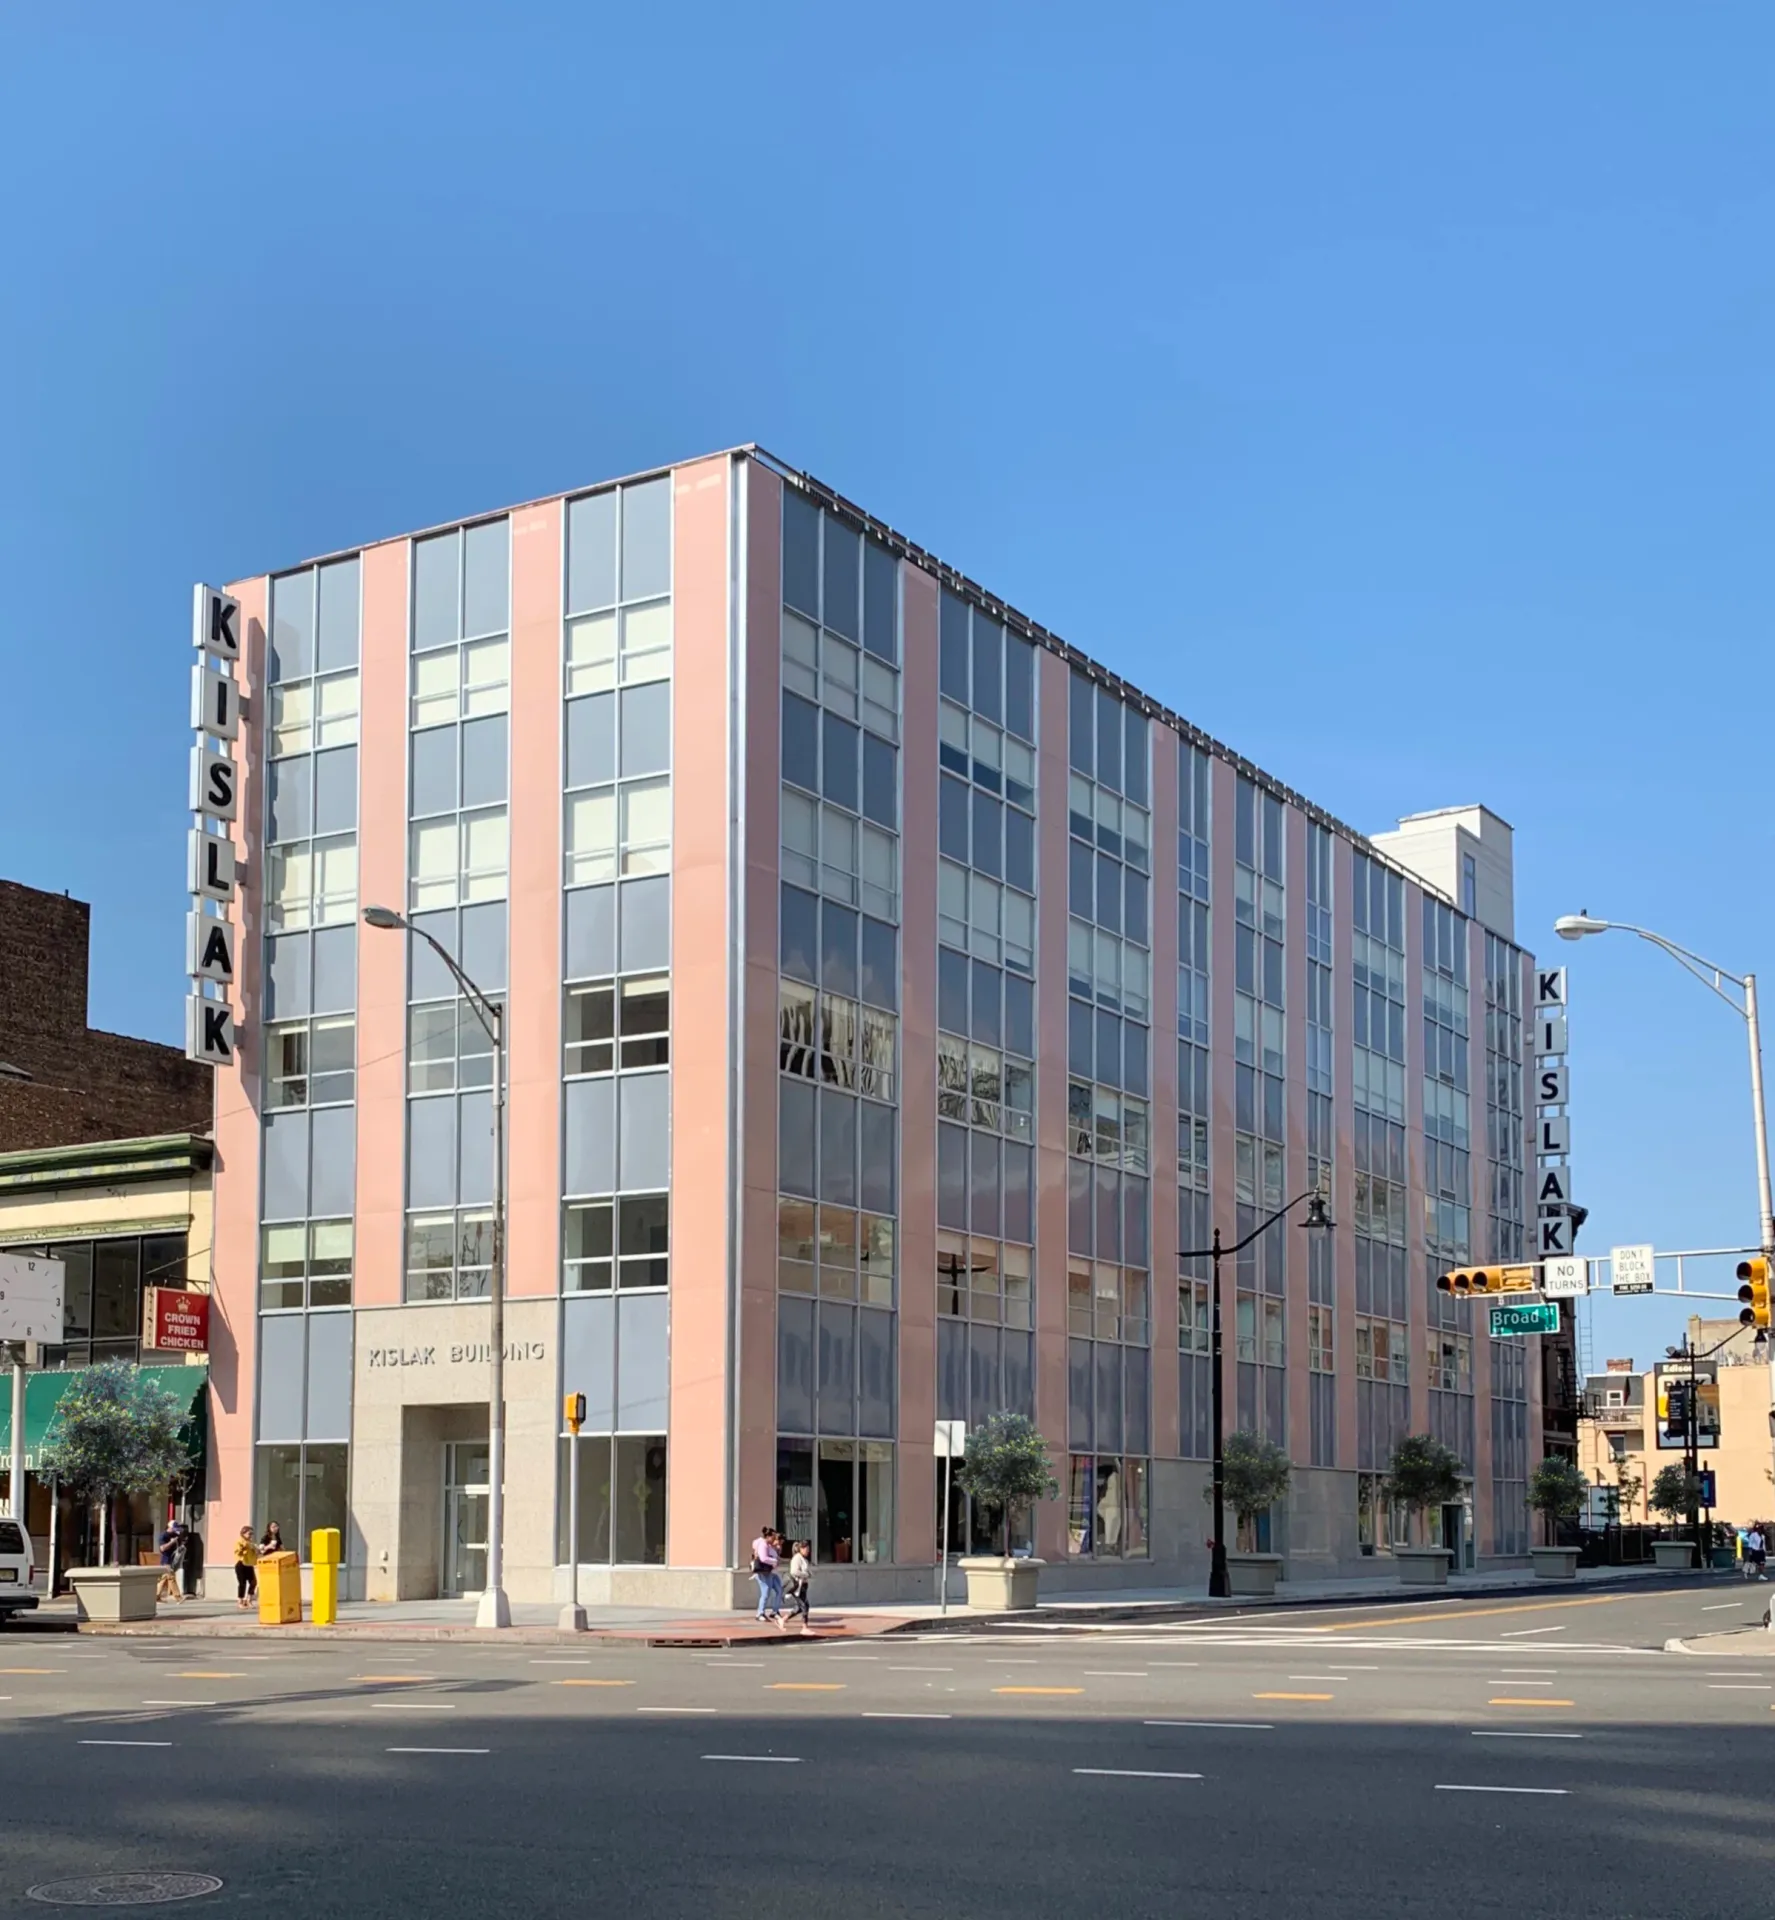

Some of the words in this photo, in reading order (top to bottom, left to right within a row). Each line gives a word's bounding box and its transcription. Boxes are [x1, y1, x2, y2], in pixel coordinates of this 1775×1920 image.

[201, 596, 238, 1056] KISLAK
[1540, 972, 1564, 1251] KISLAK
[28, 1261, 36, 1272] 12
[1557, 1265, 1575, 1277] NO
[1619, 1261, 1646, 1272] BLOCK
[1615, 1273, 1630, 1283] THE
[1634, 1272, 1651, 1282] BOX
[1549, 1280, 1584, 1290] TURNS
[56, 1297, 61, 1307] 3
[164, 1312, 201, 1325] CROWN
[1492, 1309, 1540, 1326] Broad
[26, 1326, 32, 1336] 6
[167, 1324, 197, 1336] FRIED
[160, 1336, 204, 1349] CHICKEN
[369, 1347, 436, 1367] KISLAK
